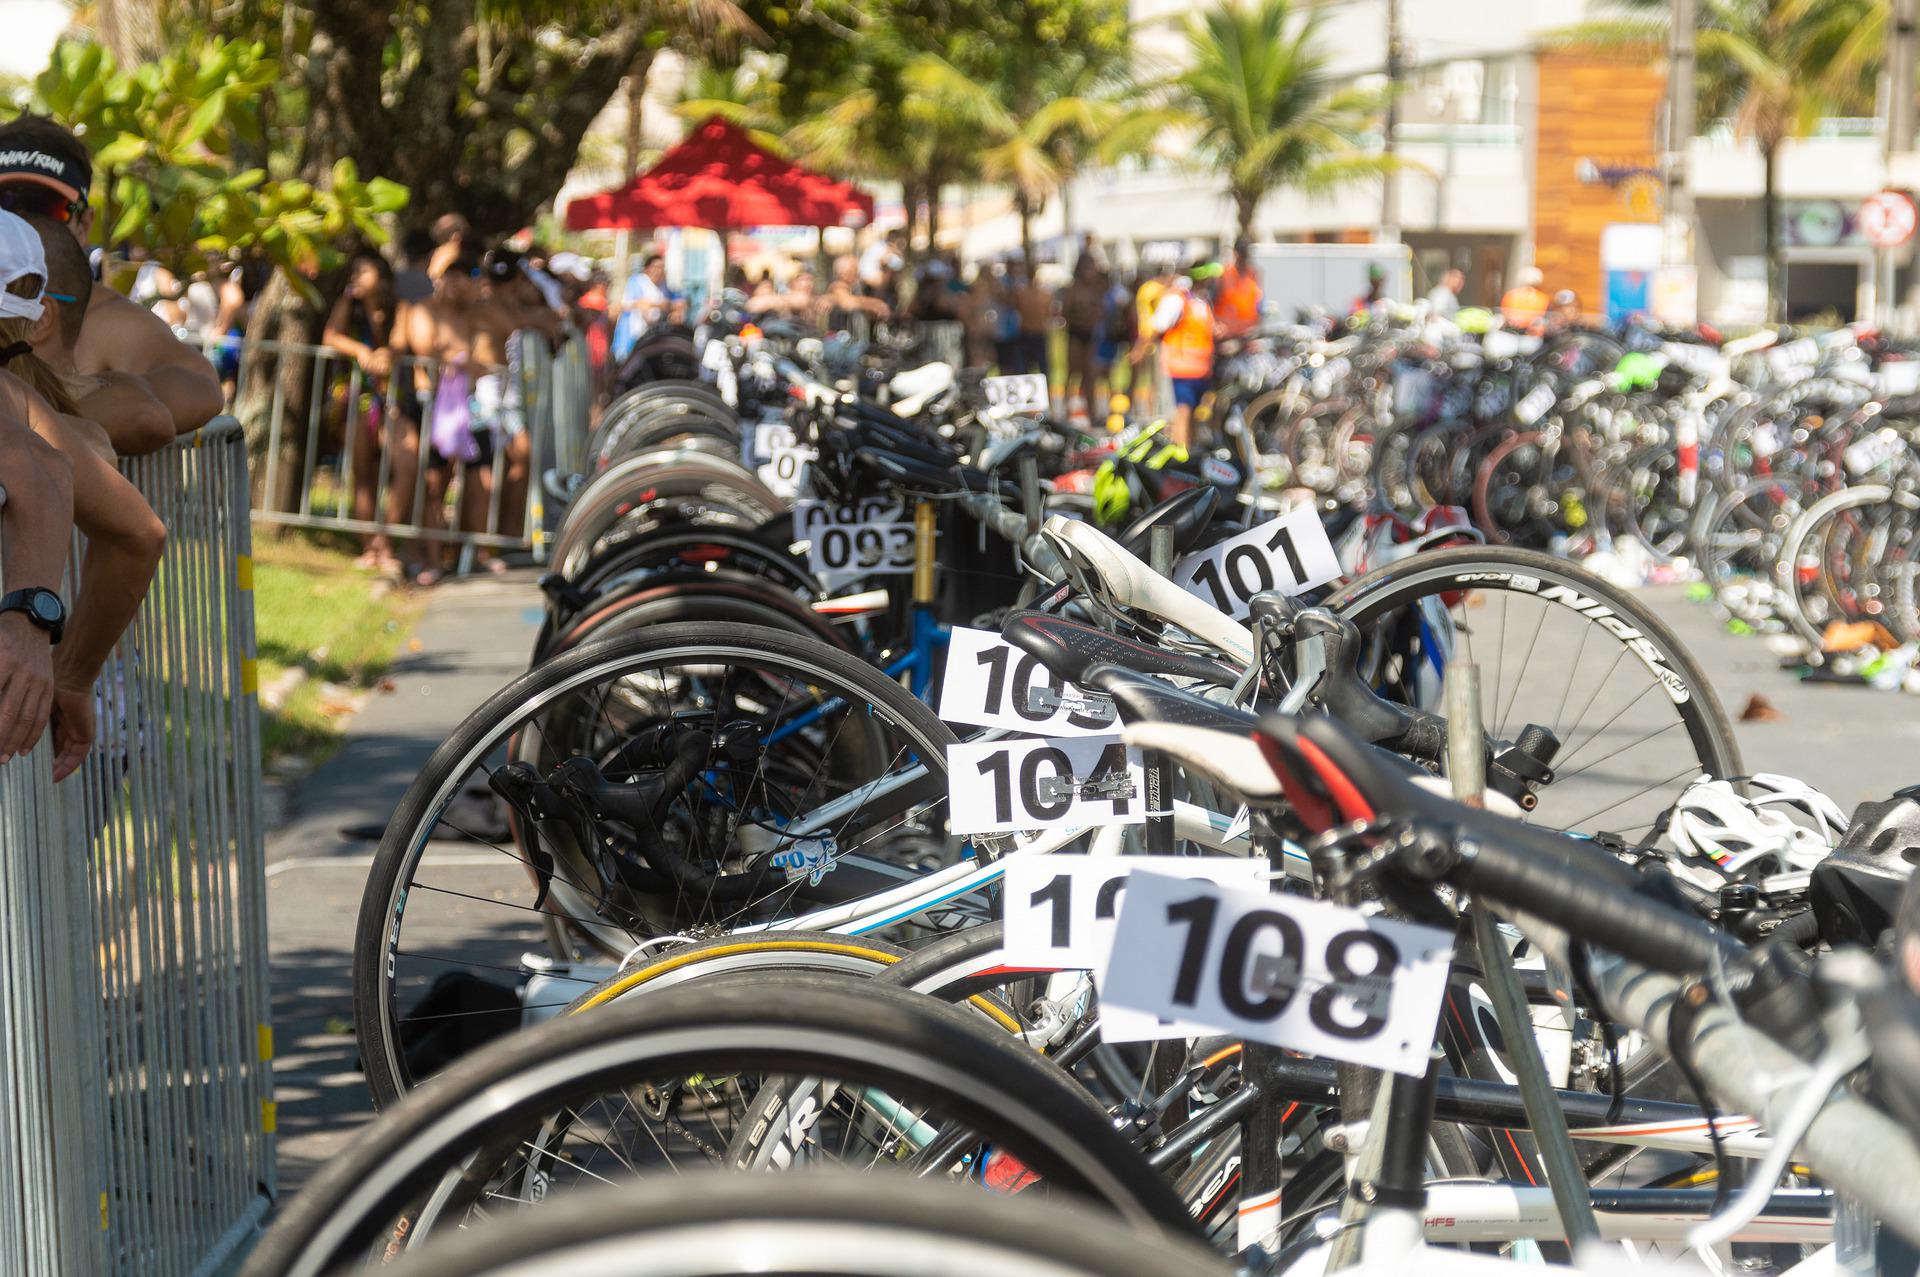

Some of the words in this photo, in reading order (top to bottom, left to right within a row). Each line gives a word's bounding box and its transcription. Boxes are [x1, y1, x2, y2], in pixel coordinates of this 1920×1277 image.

[822, 528, 915, 568] 093
[1191, 526, 1310, 616] 101
[976, 743, 1137, 823] 104
[1166, 895, 1399, 1040] 108
[1424, 1217, 1456, 1228] HFS
